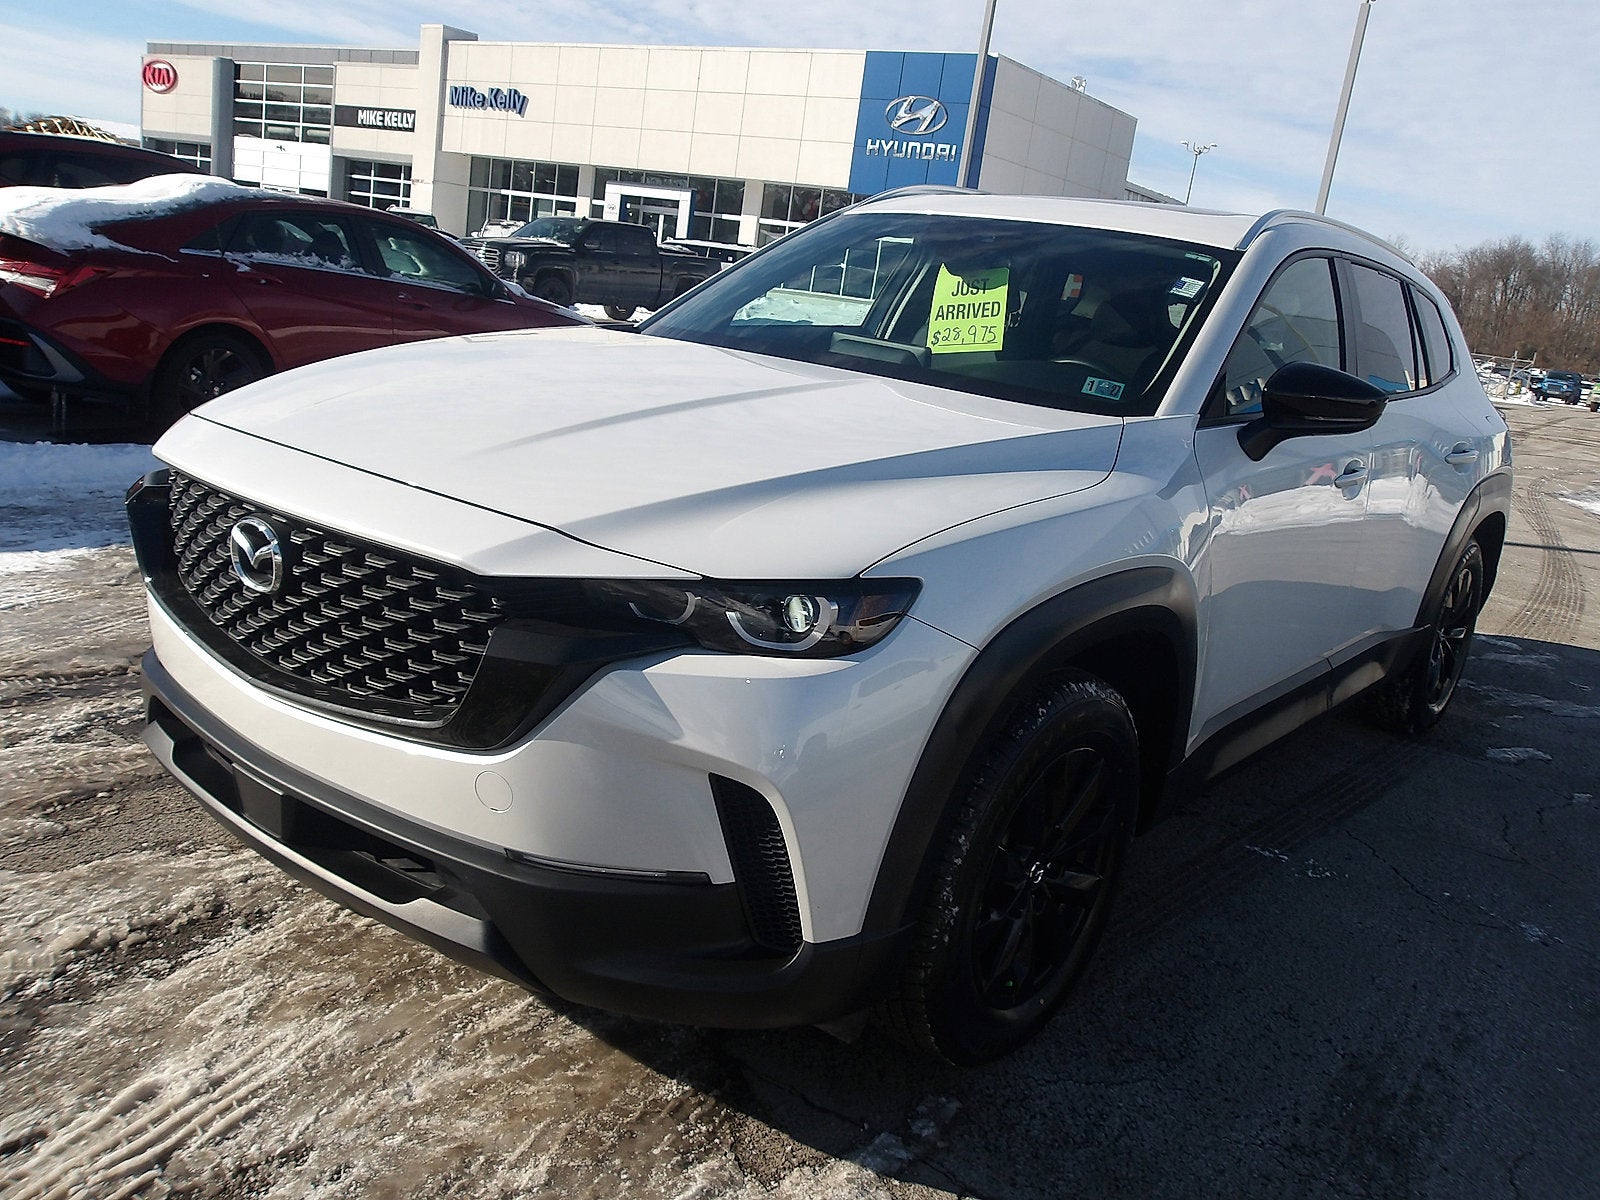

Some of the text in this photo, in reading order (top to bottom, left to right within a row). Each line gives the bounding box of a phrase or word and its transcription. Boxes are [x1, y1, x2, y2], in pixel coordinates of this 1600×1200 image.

[144, 64, 174, 87] KIA
[449, 85, 529, 118] Mike Kelly
[357, 109, 415, 129] MIKE KELLY
[866, 138, 957, 161] HYUNDAI
[951, 278, 989, 297] JUST
[934, 301, 1001, 321] ARRIVED
[931, 324, 998, 346] $28,975
